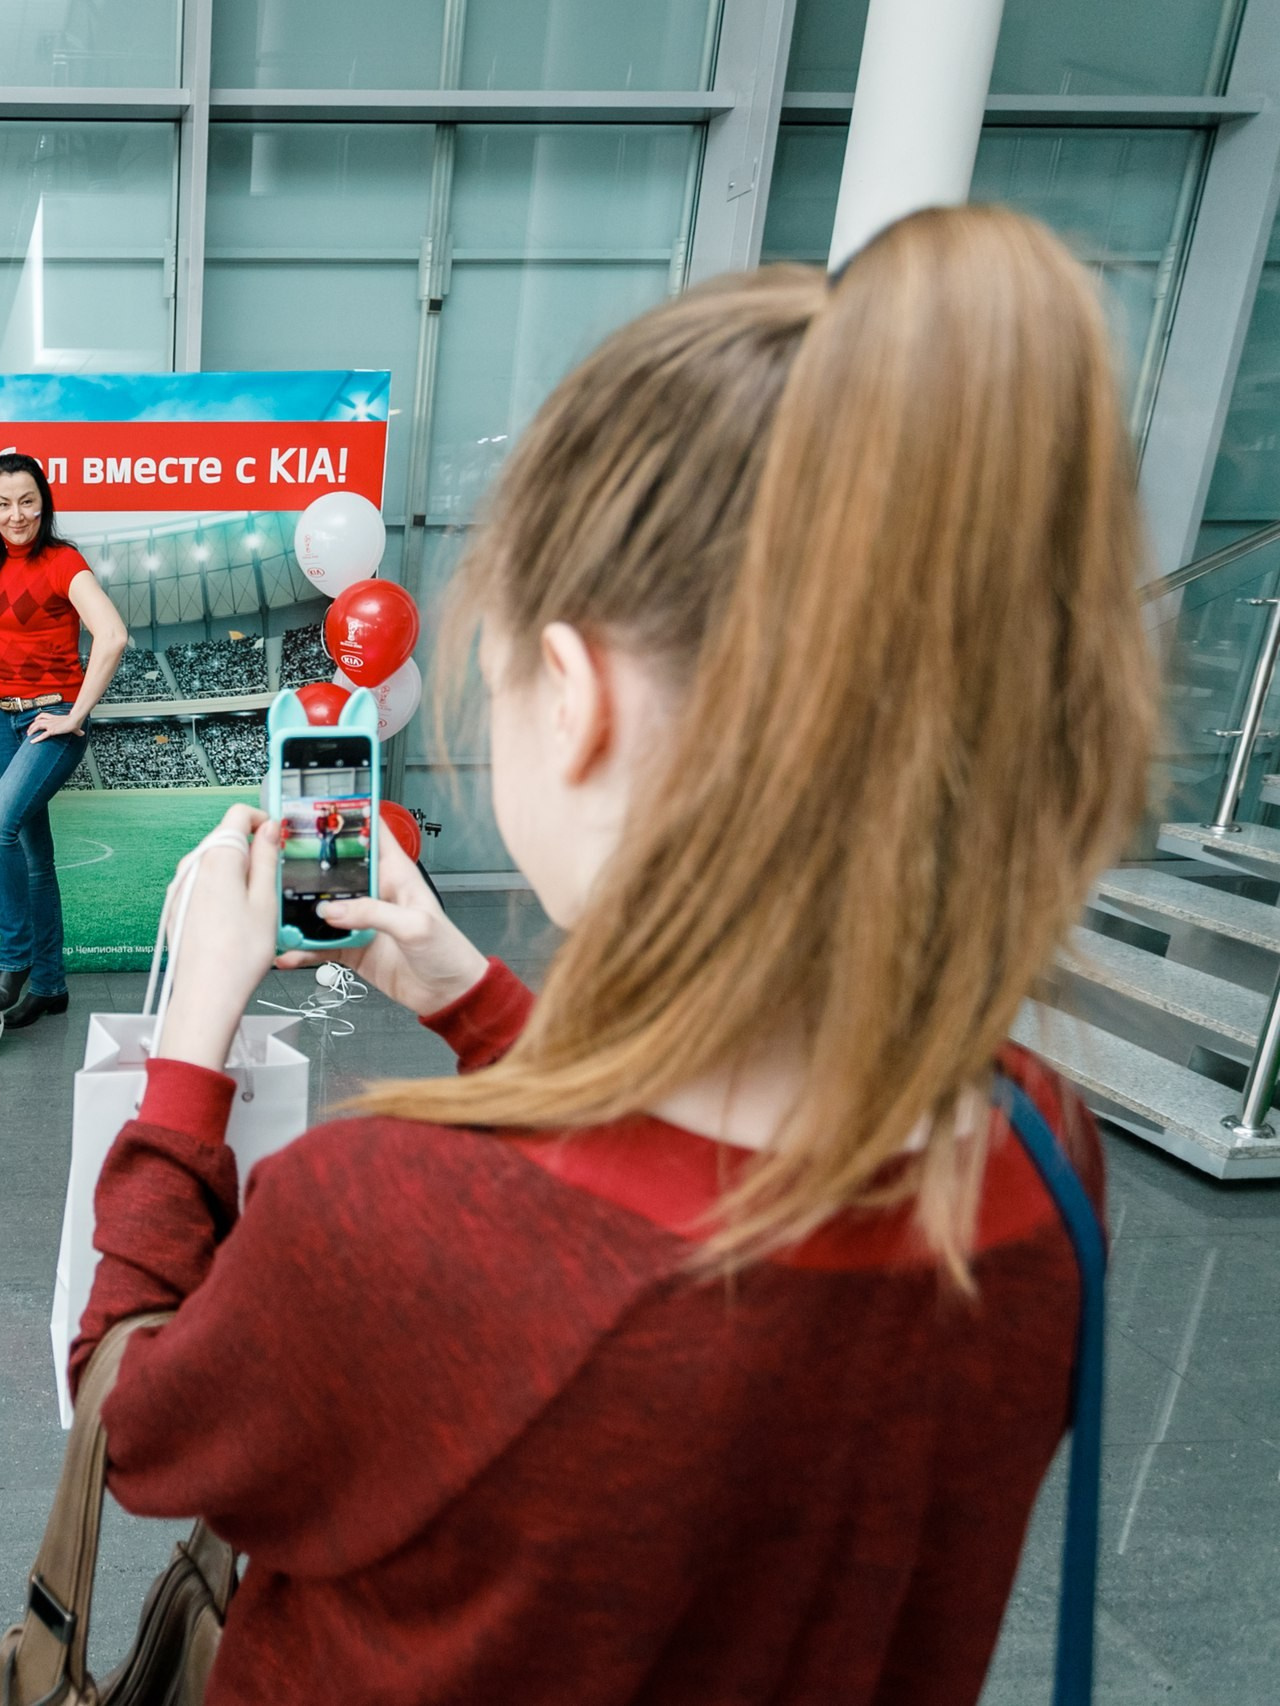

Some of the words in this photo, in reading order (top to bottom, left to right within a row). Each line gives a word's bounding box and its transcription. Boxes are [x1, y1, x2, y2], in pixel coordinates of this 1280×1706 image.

[82, 456, 222, 485] вместе
[235, 456, 257, 485] с
[269, 447, 348, 484] KIA!
[75, 945, 133, 954] Чемпионата
[135, 945, 157, 954] мир
